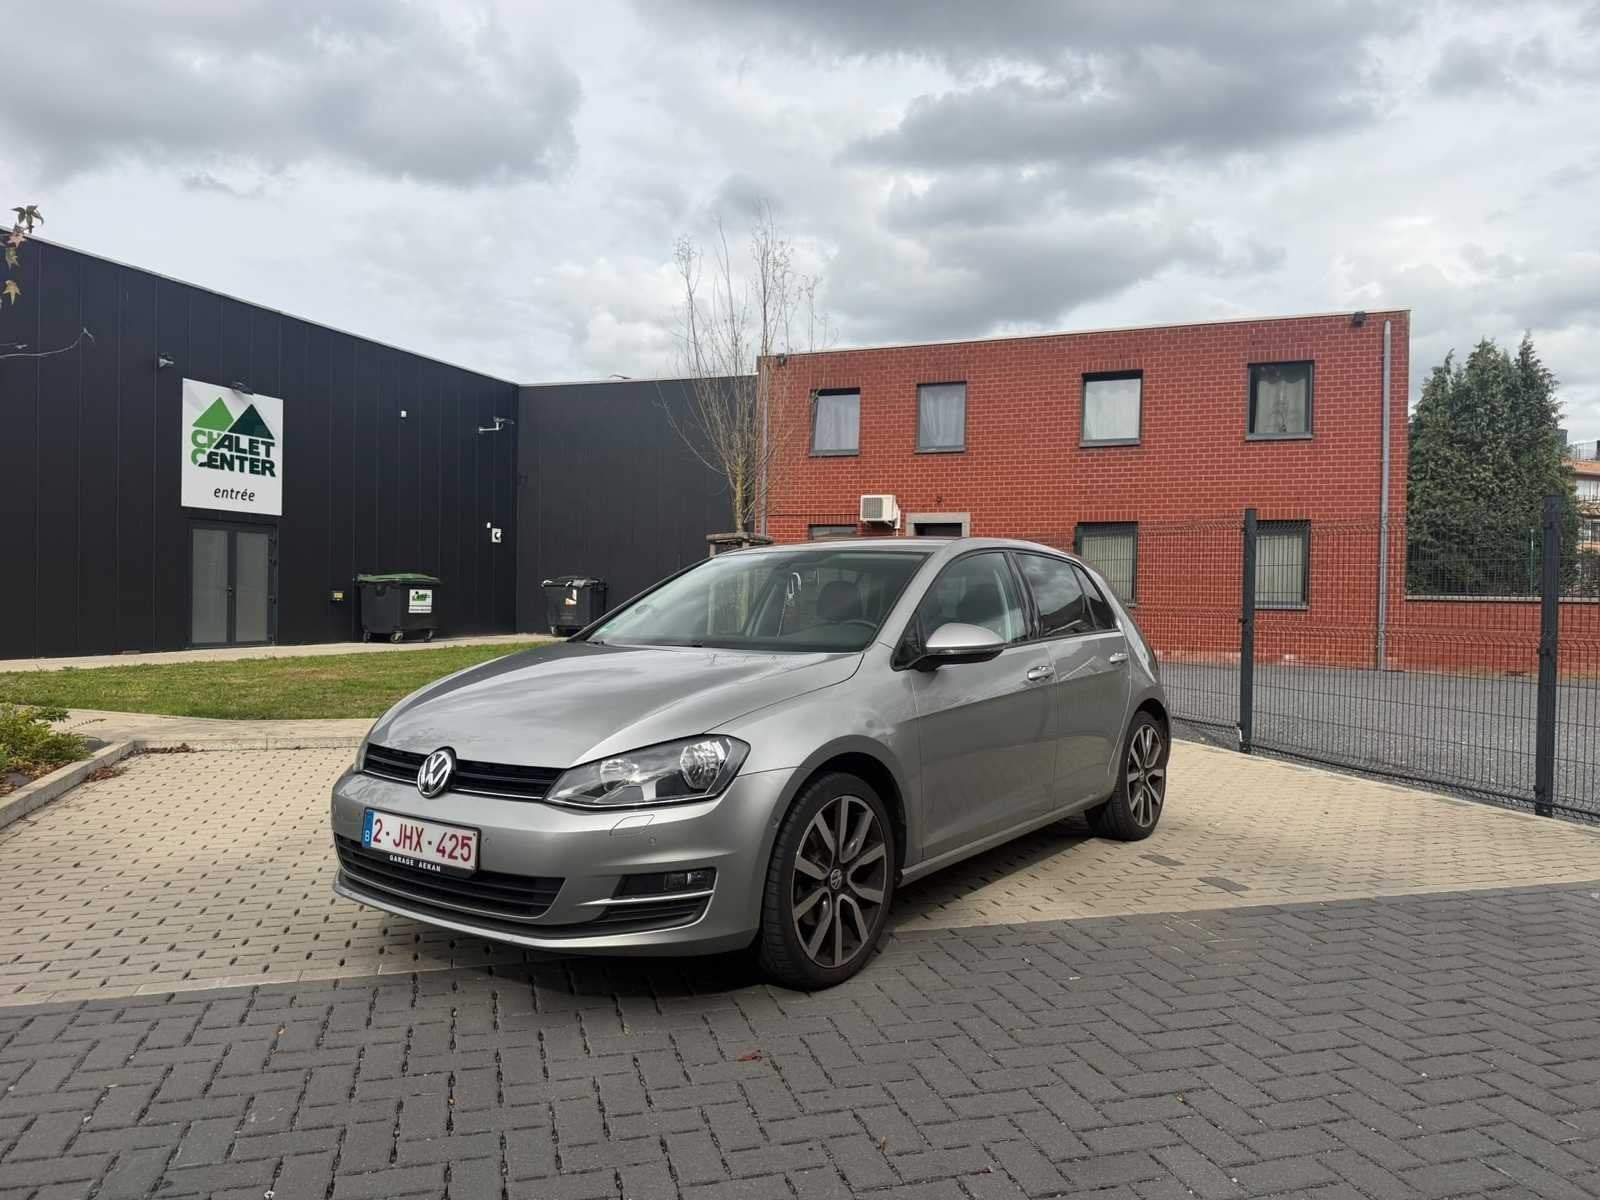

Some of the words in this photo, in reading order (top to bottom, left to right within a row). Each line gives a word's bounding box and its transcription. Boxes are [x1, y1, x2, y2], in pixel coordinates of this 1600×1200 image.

[191, 429, 275, 458] CHALET
[191, 448, 276, 477] CENTER
[213, 487, 255, 501] entrée
[365, 830, 370, 841] B
[389, 854, 414, 866] GARAGE
